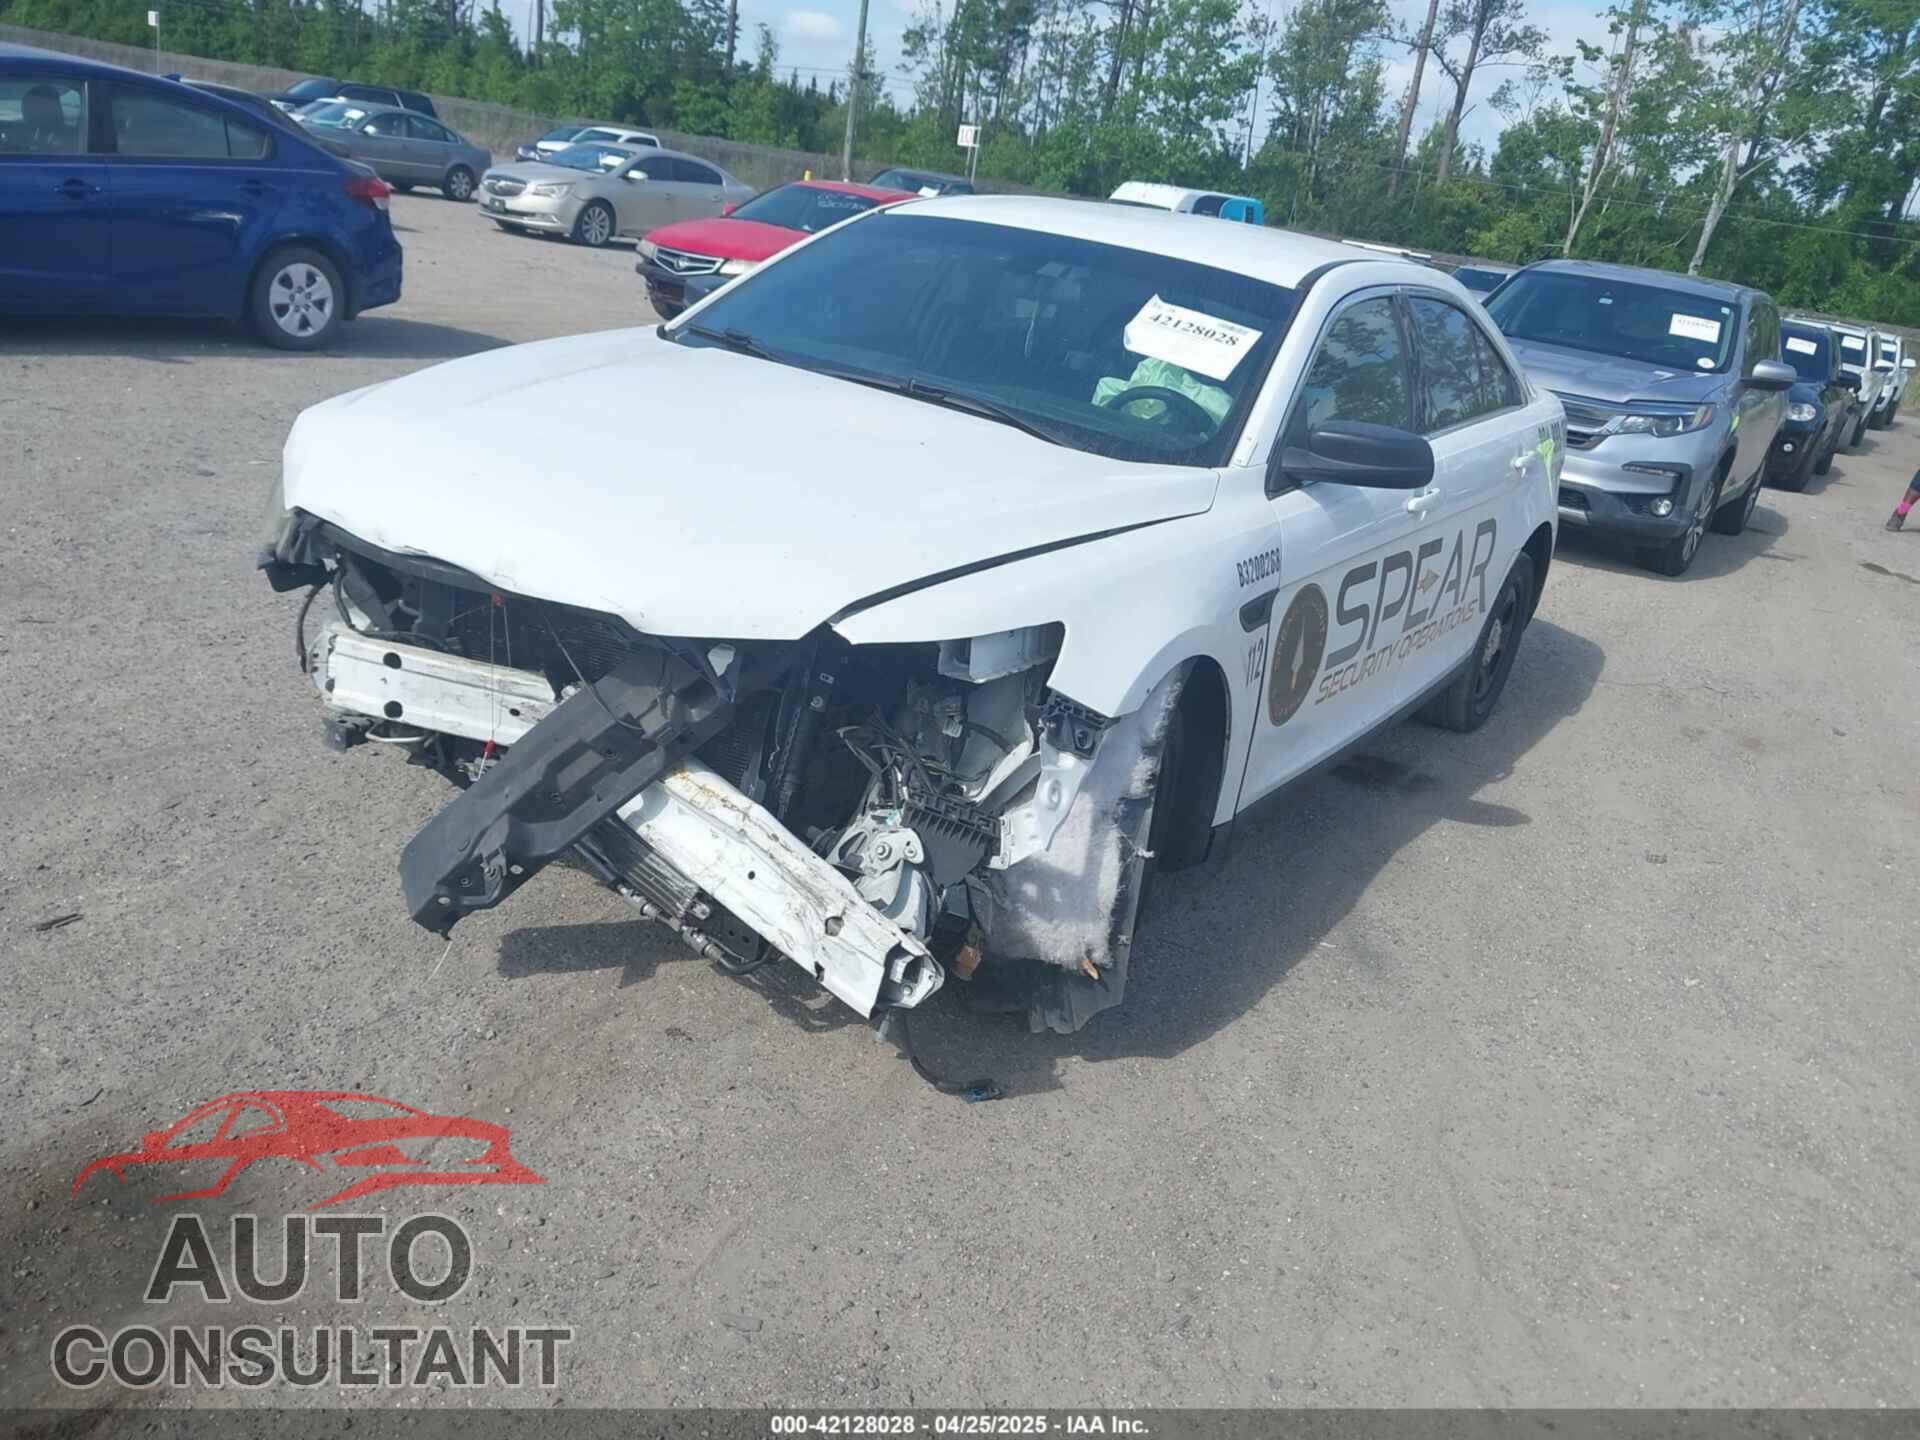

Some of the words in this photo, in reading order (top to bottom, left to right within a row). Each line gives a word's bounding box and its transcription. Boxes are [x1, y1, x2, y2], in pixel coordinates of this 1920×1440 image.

[1149, 313, 1239, 346] 42128028
[1324, 518, 1497, 670] SPEAR
[1315, 639, 1399, 705] SECURITY
